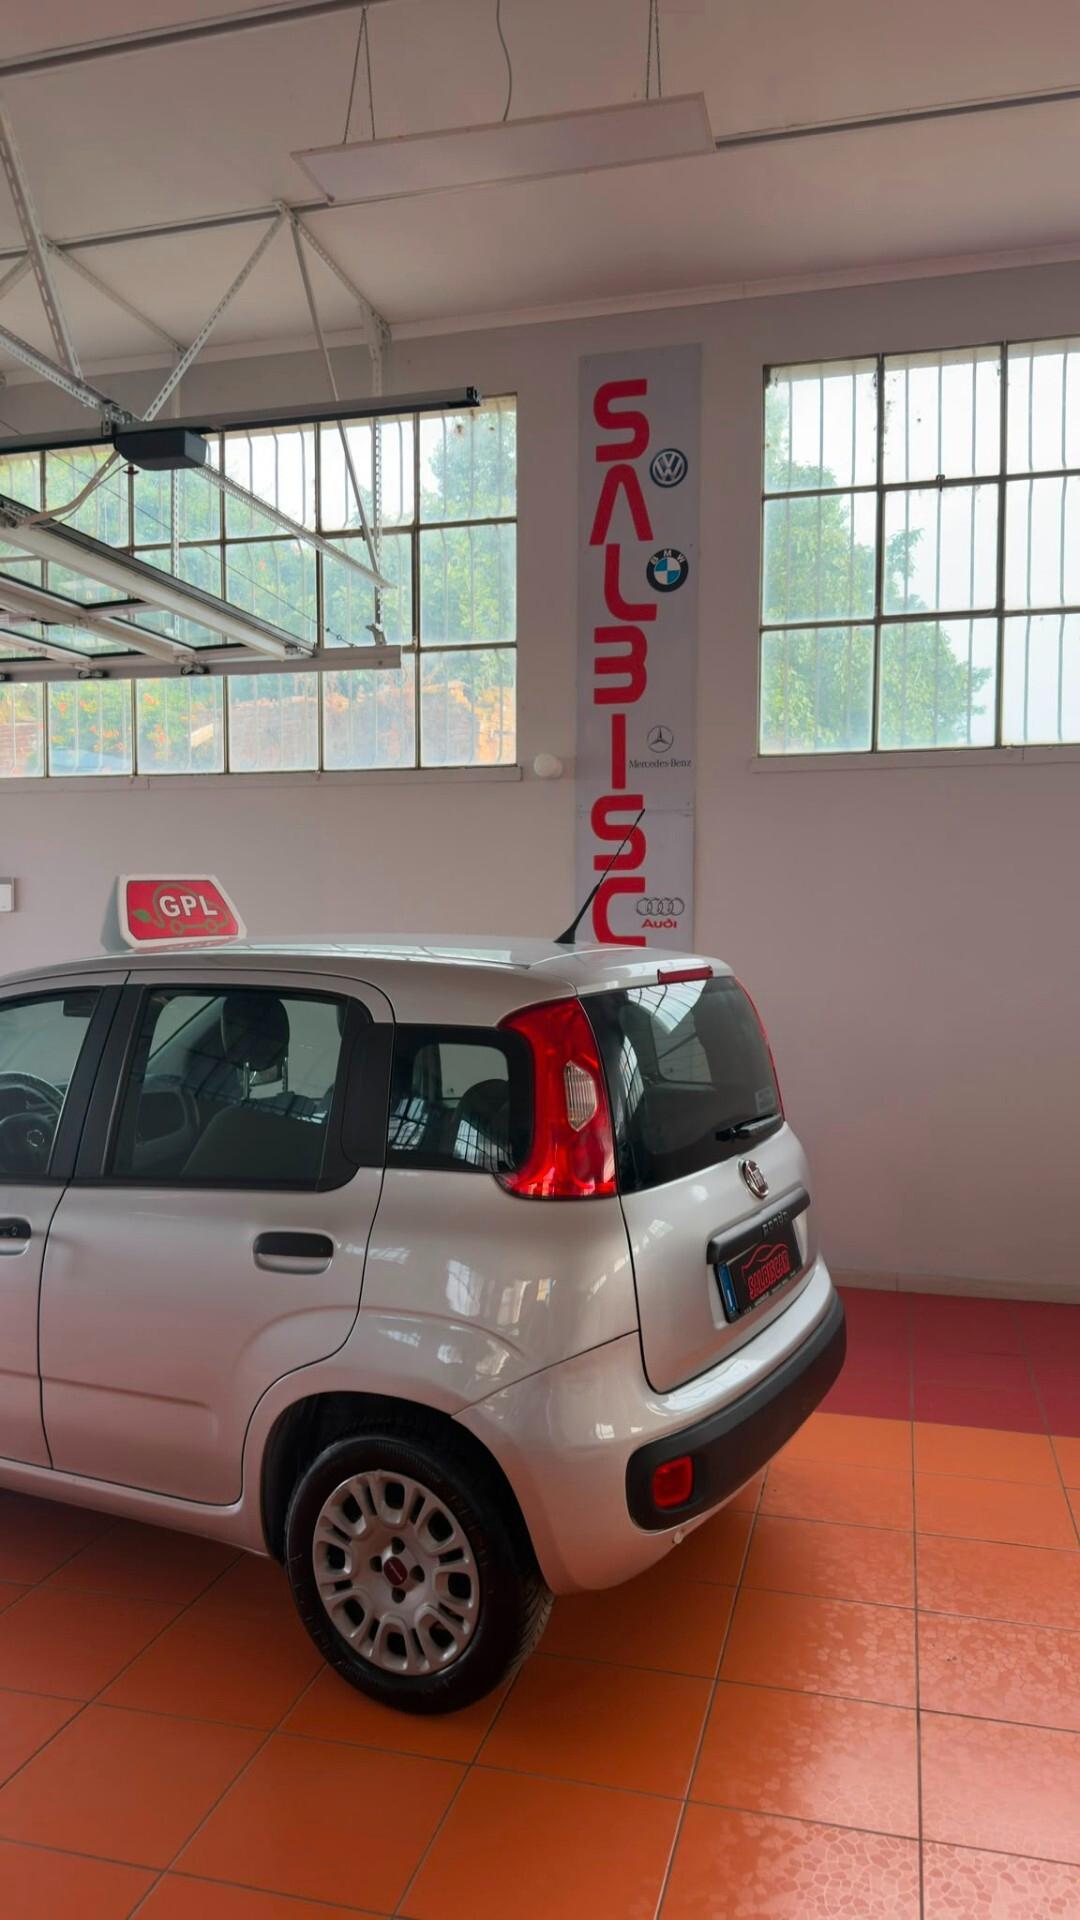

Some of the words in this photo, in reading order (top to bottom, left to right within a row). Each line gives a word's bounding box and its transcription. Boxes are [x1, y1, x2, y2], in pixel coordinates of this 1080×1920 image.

[628, 758, 692, 769] Mercedes-Benz
[159, 895, 218, 917] GPL
[641, 918, 677, 928] Audi
